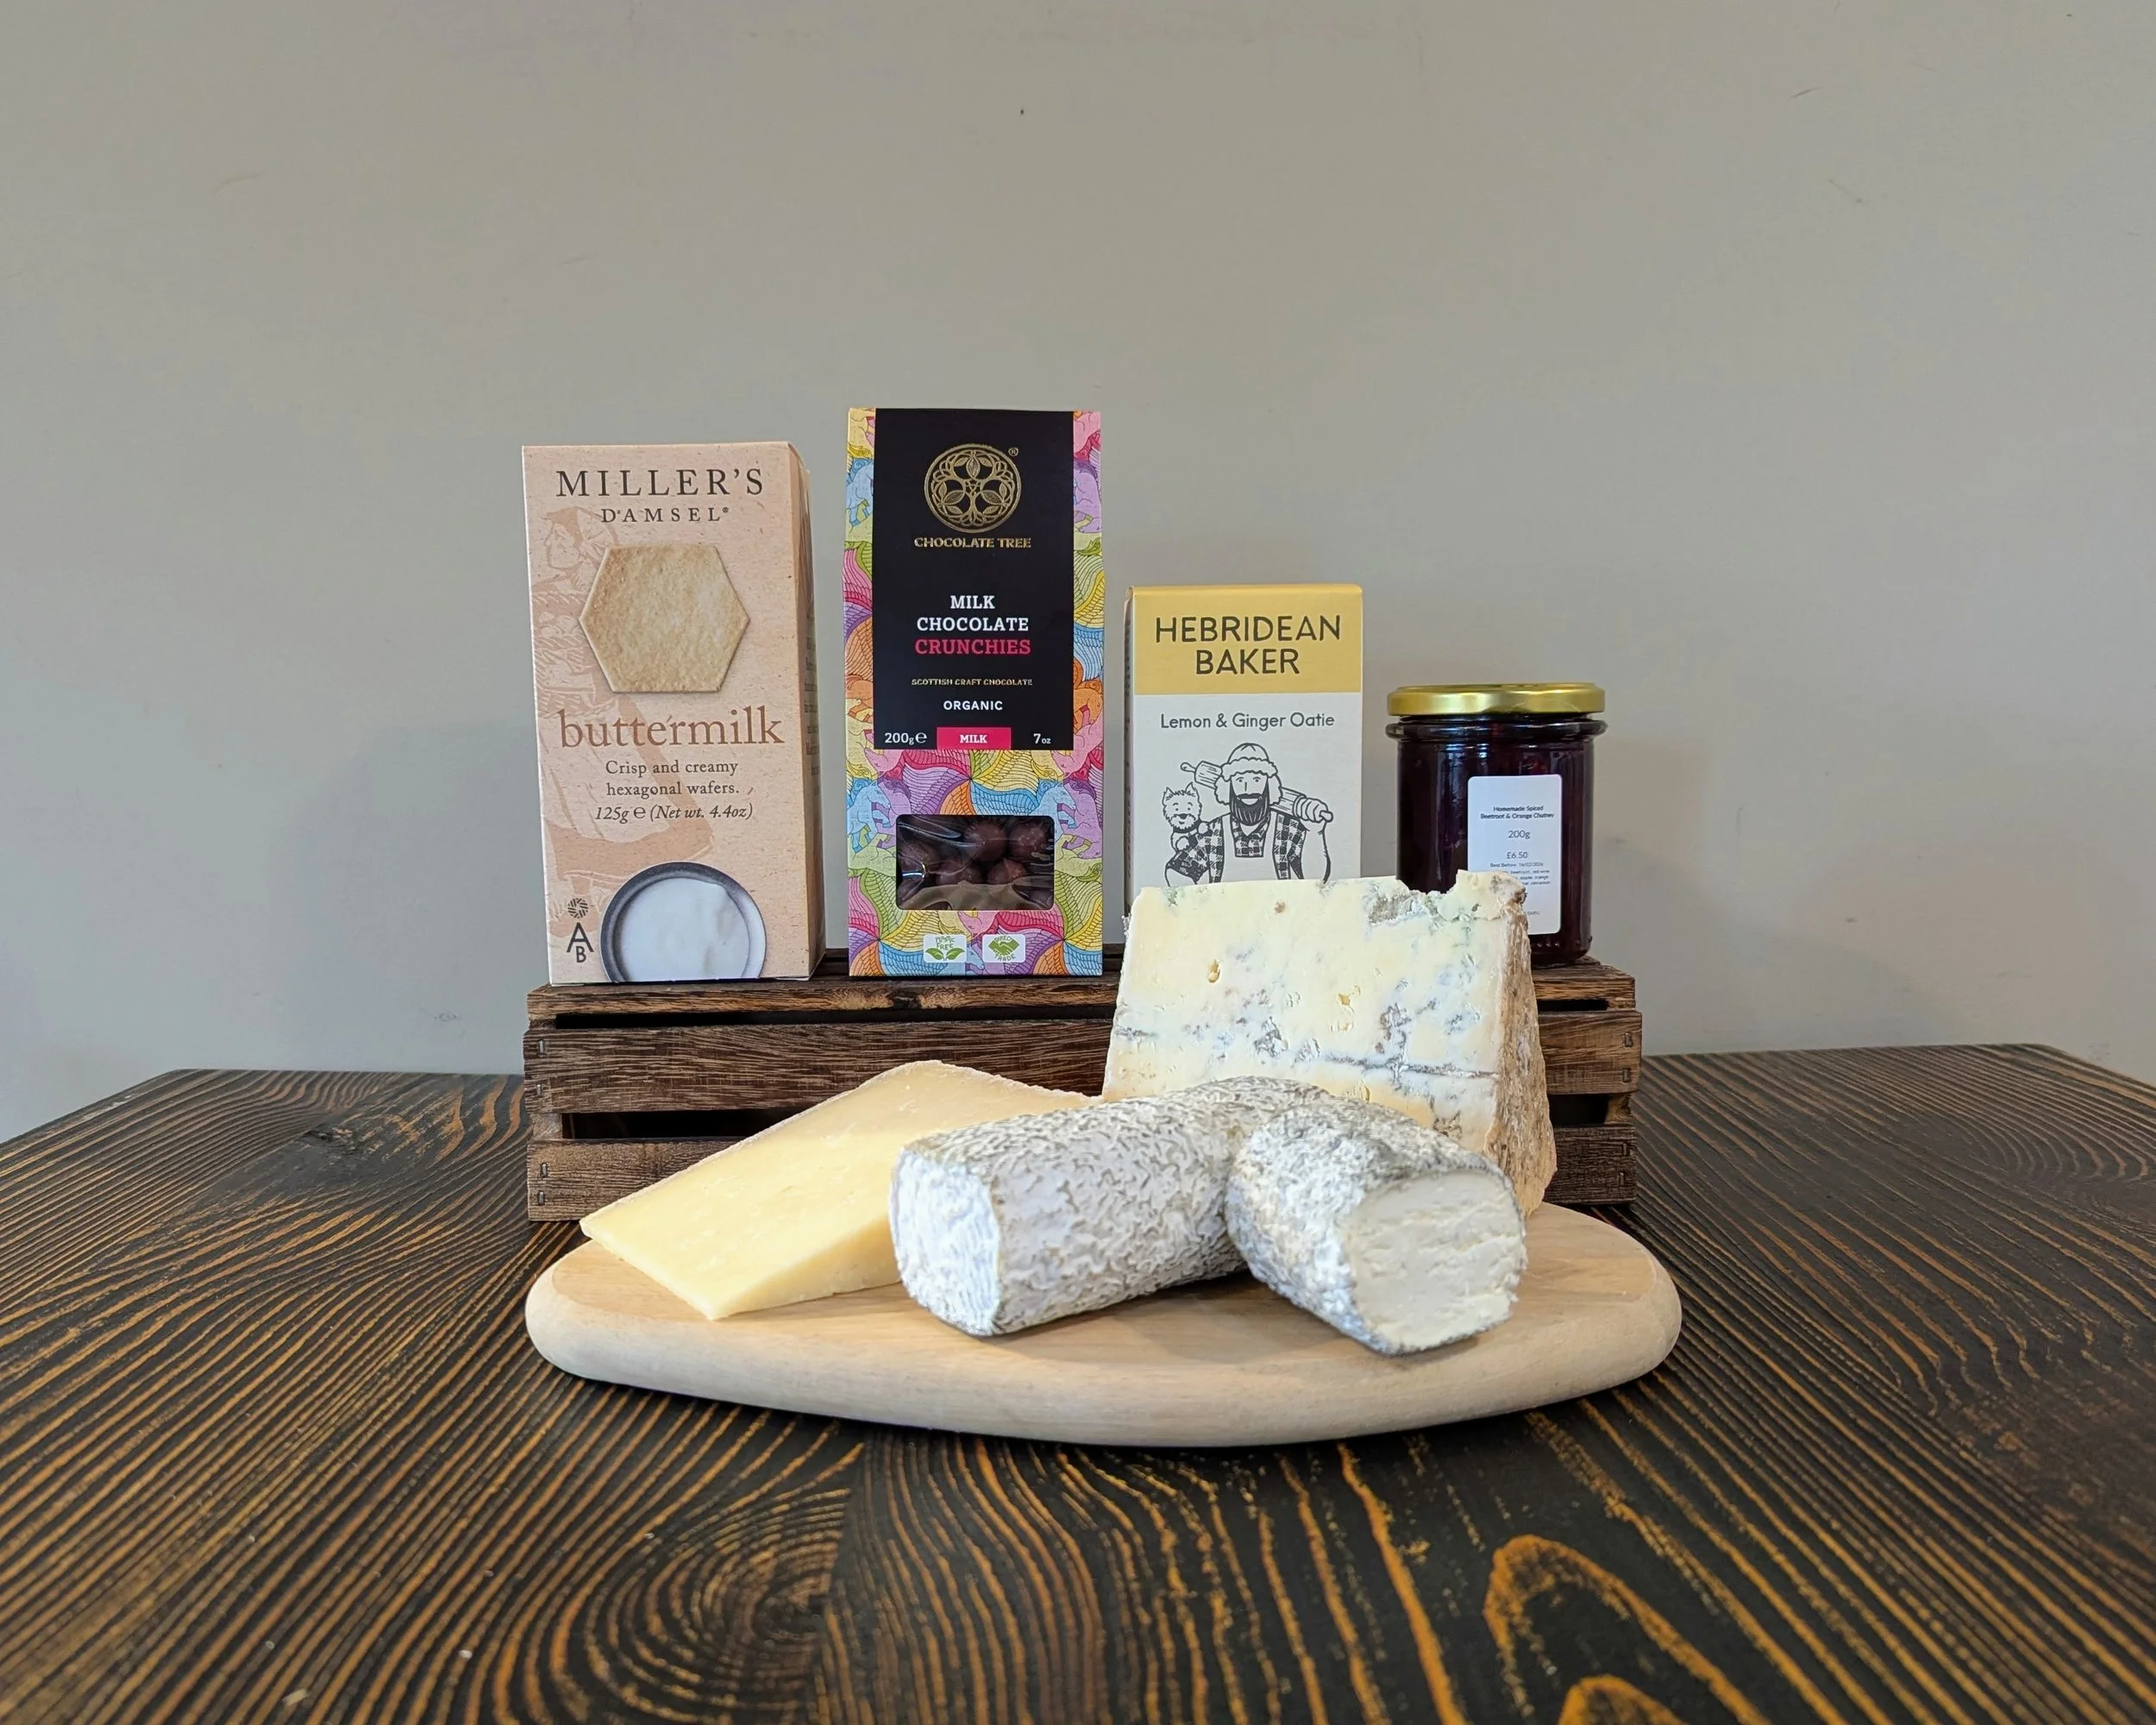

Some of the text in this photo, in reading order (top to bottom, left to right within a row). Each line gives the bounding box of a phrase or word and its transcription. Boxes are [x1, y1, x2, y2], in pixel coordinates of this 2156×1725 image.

[556, 468, 763, 497] MILLER'S
[914, 537, 1032, 549] CHOCOLATE TREE
[950, 595, 995, 609] MILK
[916, 617, 1029, 631] CHOCOLATE
[1155, 615, 1341, 643] HEBRIDEAN
[914, 639, 1031, 655] CRUNCHIES
[1195, 649, 1300, 675] BAKER
[943, 700, 1003, 711] ORGANIC
[559, 706, 785, 748] buttermilk
[1160, 712, 1335, 731] Lemon & Ginger Oatie
[959, 735, 987, 743] MILK
[605, 759, 738, 777] Crisp and creamy
[606, 782, 739, 800] hexagonal wafers.
[650, 805, 681, 821] (Net
[685, 806, 705, 819] wt.
[710, 803, 754, 819] 4.4oz)
[1507, 830, 1531, 839] 200g
[993, 953, 1016, 962] TRADE
